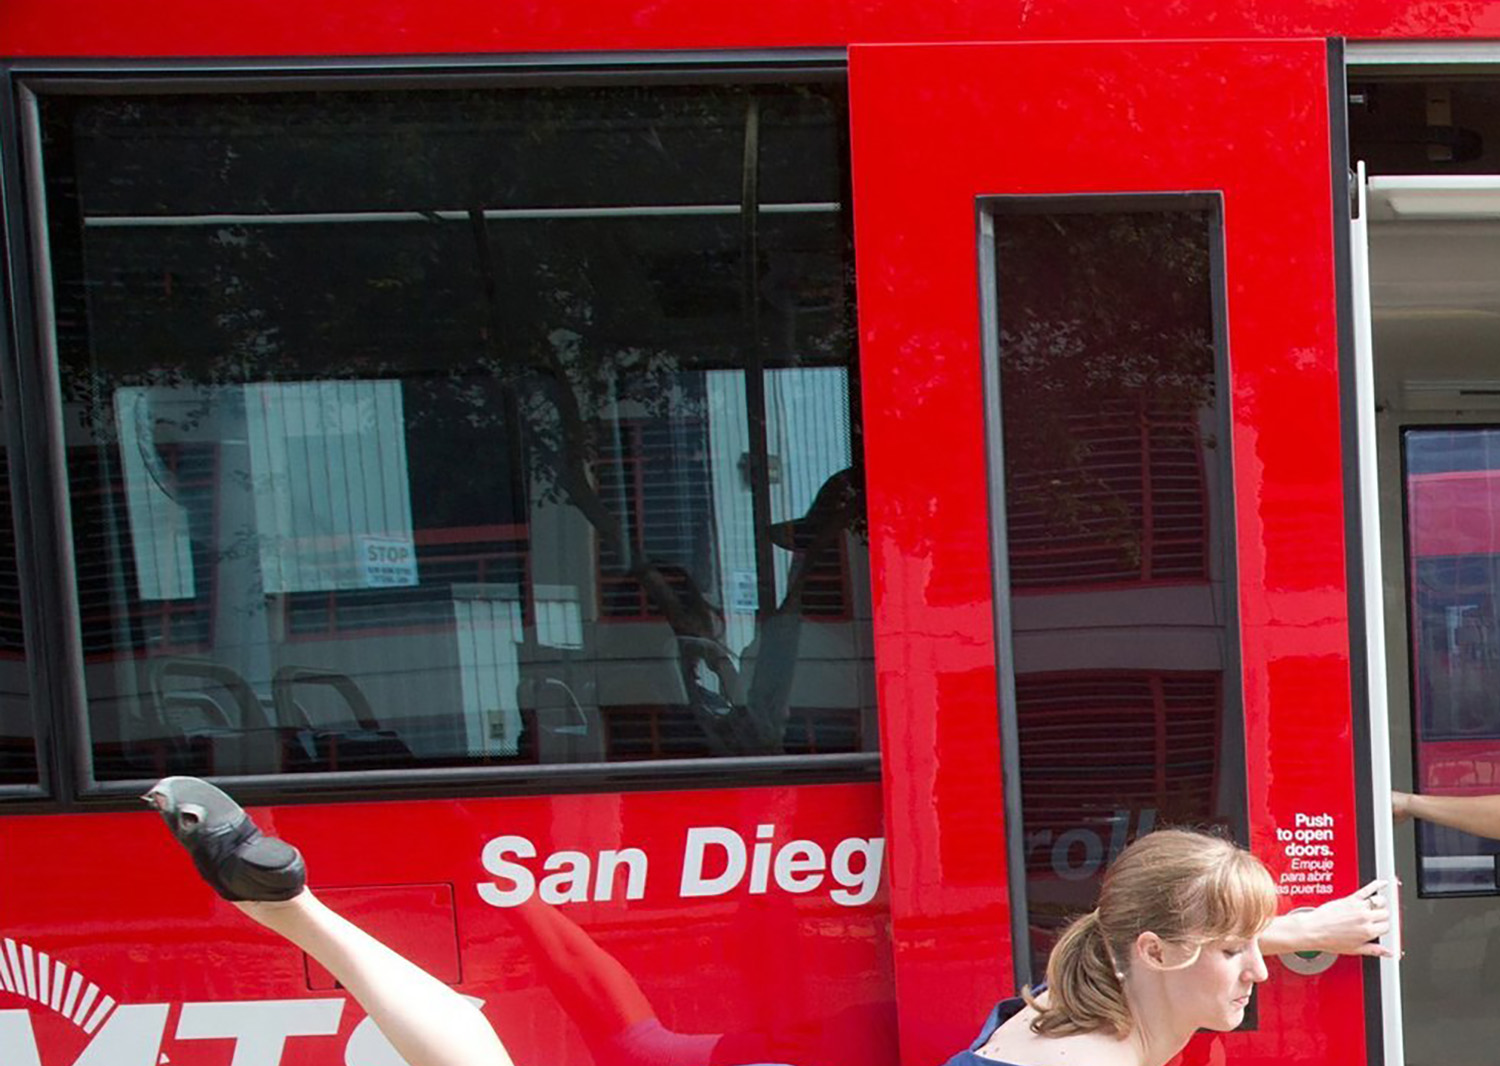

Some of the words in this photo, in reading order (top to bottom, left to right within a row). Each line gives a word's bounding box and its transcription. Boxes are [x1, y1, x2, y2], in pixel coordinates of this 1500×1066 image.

[368, 544, 408, 563] STOP
[1295, 812, 1334, 827] Push
[1276, 828, 1293, 841] to
[1295, 829, 1334, 844] open
[1285, 842, 1334, 857] doors.
[476, 834, 649, 908] San
[678, 823, 886, 907] Dieg
[1291, 858, 1334, 872] Empuje
[1280, 872, 1305, 884] para
[1307, 870, 1334, 882] abrir
[1274, 884, 1289, 895] as
[1290, 883, 1334, 896] puertas
